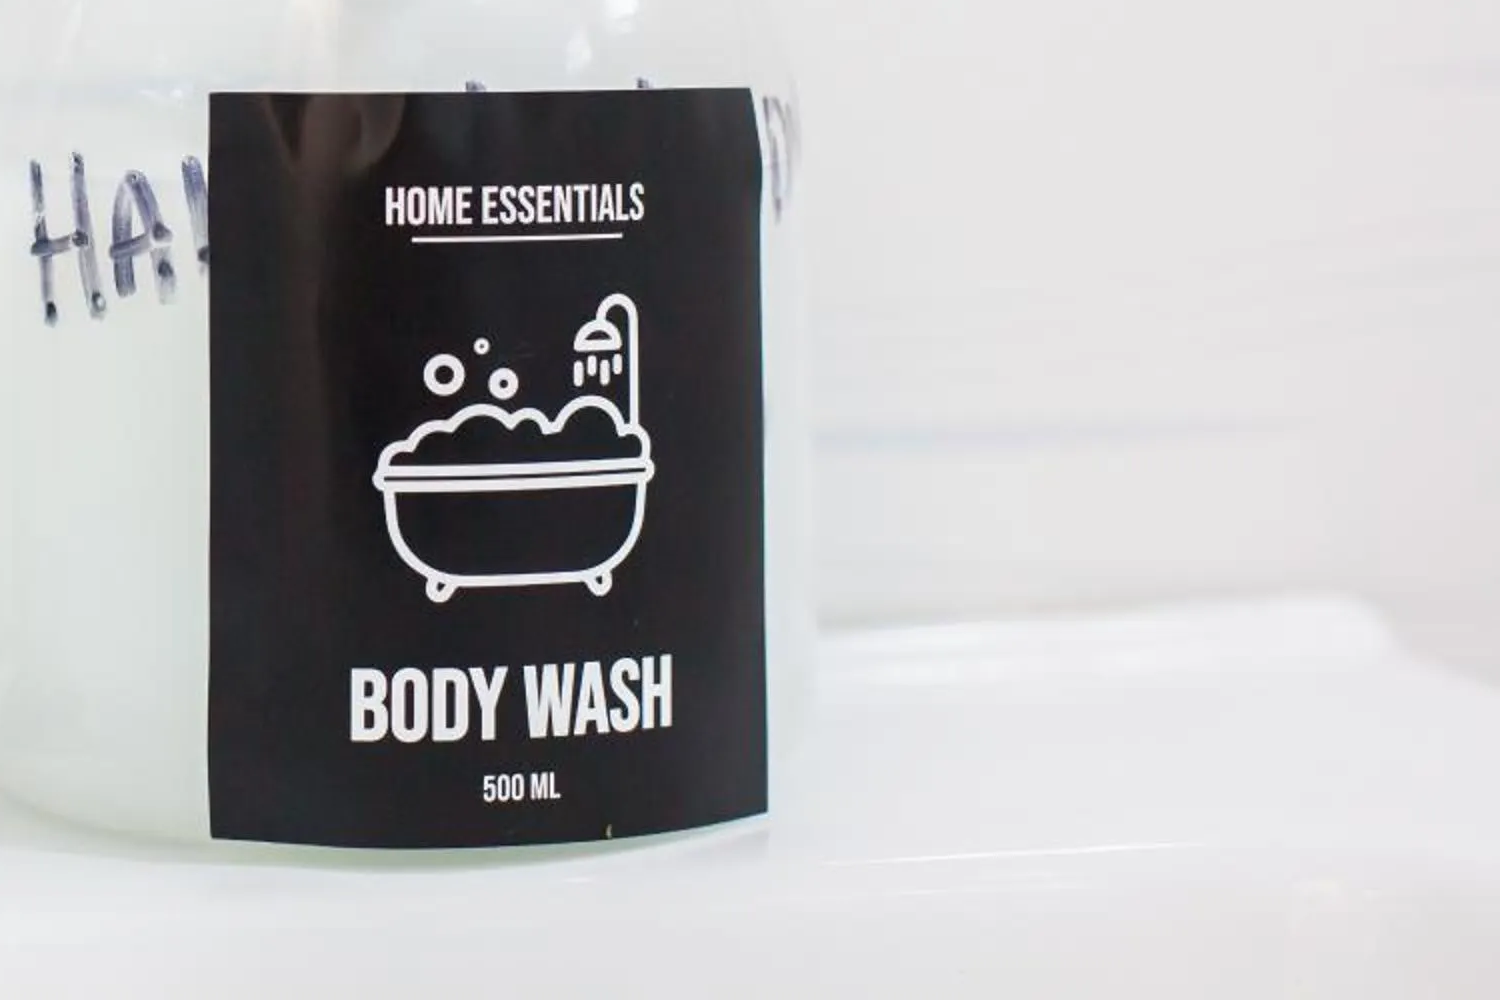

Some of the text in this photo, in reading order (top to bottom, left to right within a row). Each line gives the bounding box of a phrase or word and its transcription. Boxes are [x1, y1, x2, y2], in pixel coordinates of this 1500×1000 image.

[385, 181, 645, 226] HOME ESSENTIALS
[350, 653, 673, 744] BODY WASH
[482, 771, 562, 803] 500 ML
